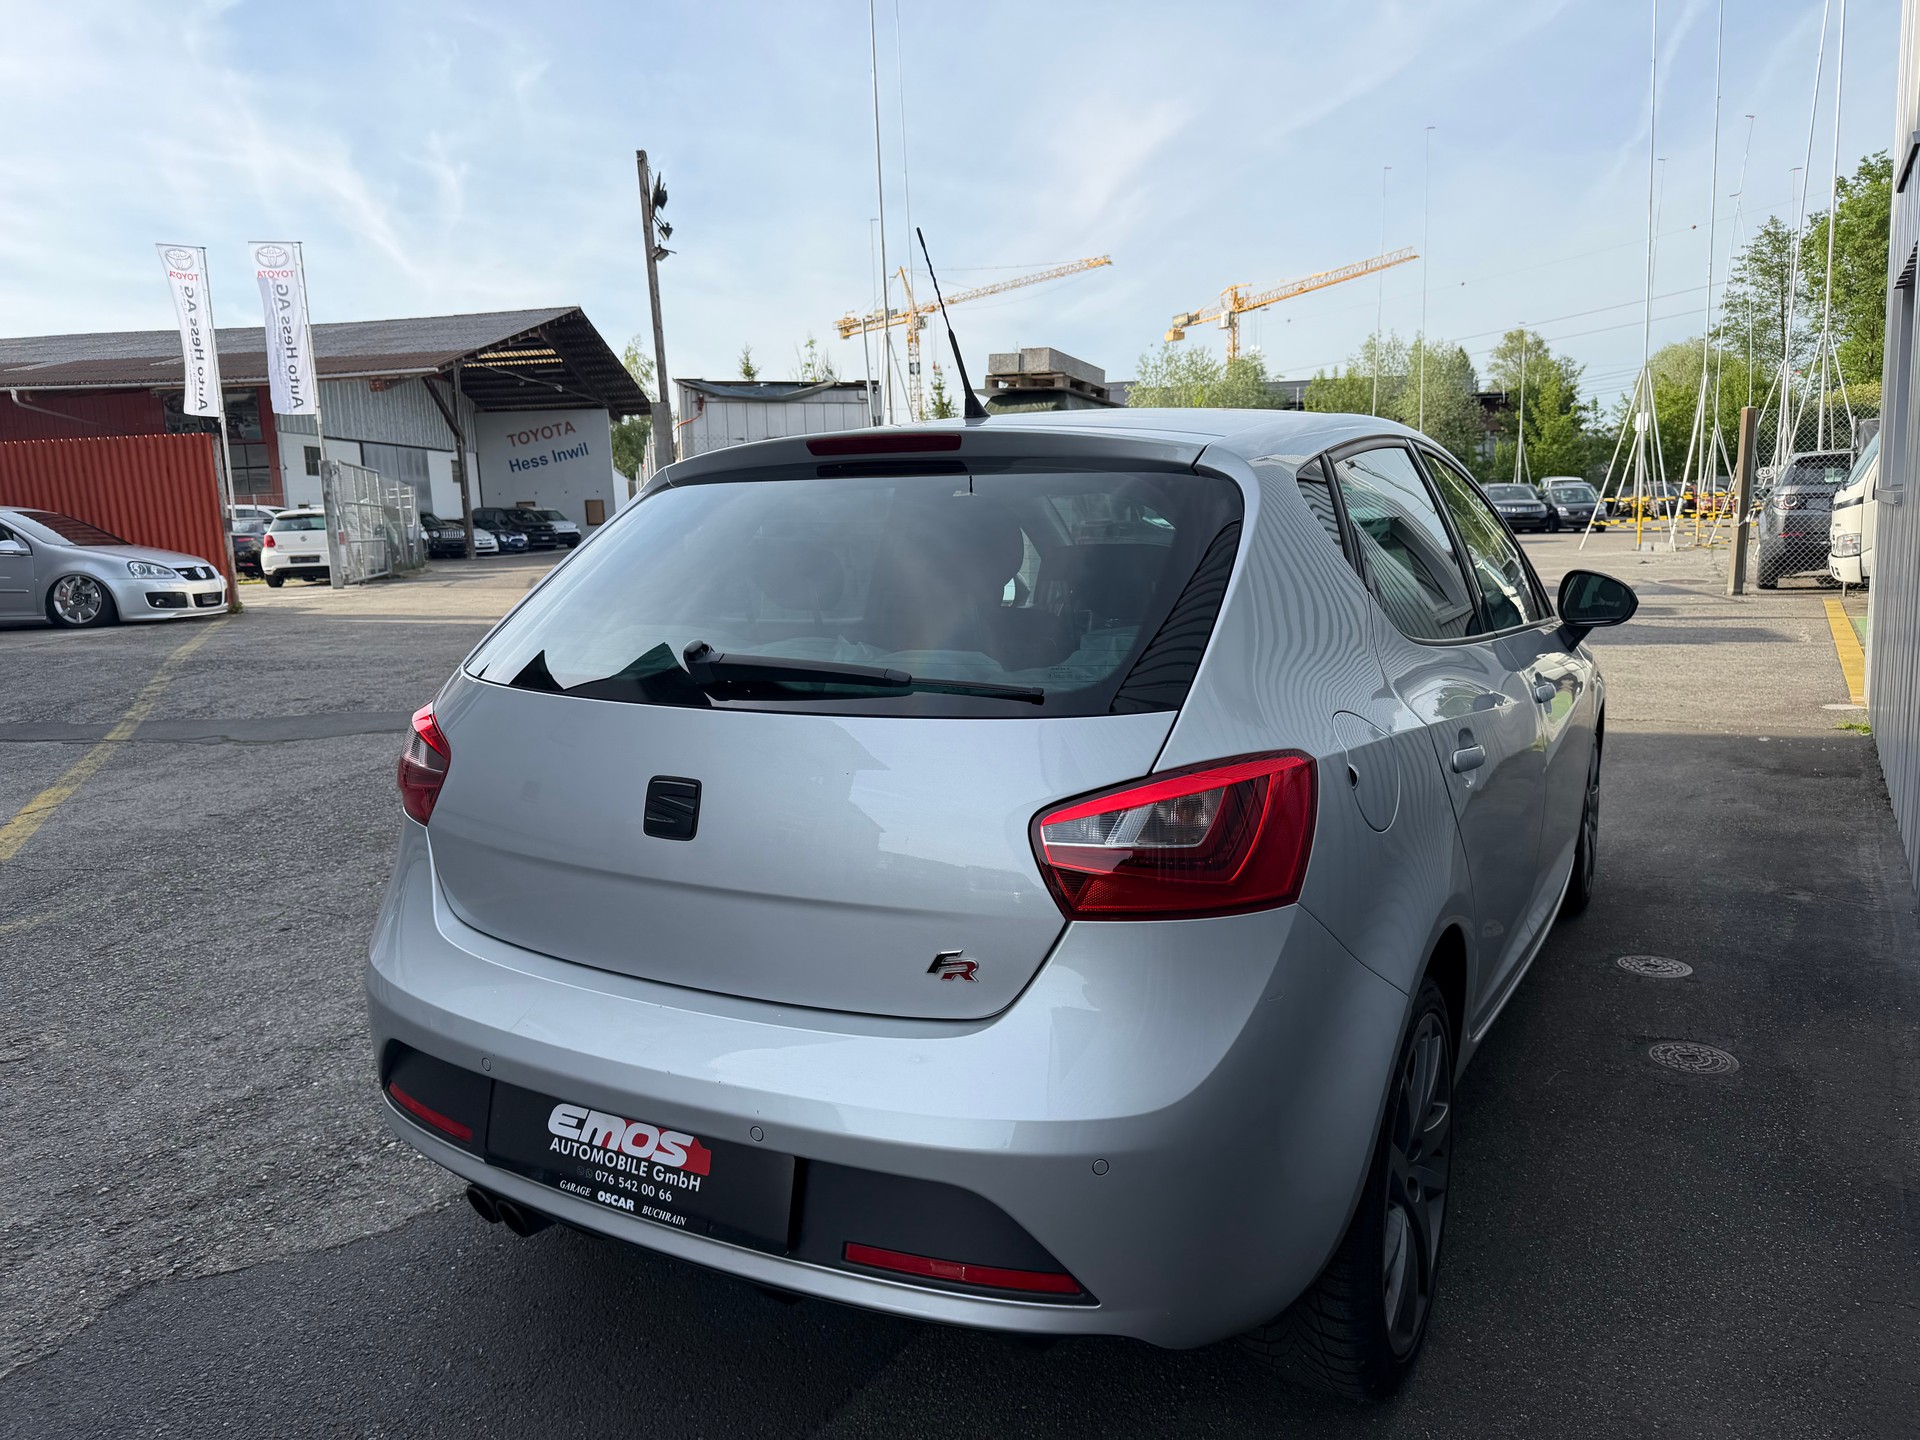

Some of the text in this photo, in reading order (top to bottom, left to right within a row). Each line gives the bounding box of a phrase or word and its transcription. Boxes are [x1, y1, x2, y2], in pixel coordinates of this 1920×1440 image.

[506, 421, 576, 447] TOYOTA
[508, 442, 589, 472] Hess Inwil
[926, 949, 980, 982] FR
[548, 1103, 694, 1167] EMOS
[549, 1137, 701, 1192] AUTOMOBILE GmbH
[595, 1170, 673, 1202] 076 542 00 66
[559, 1180, 687, 1226] GARAGE OSCAR BUCHRAIN
